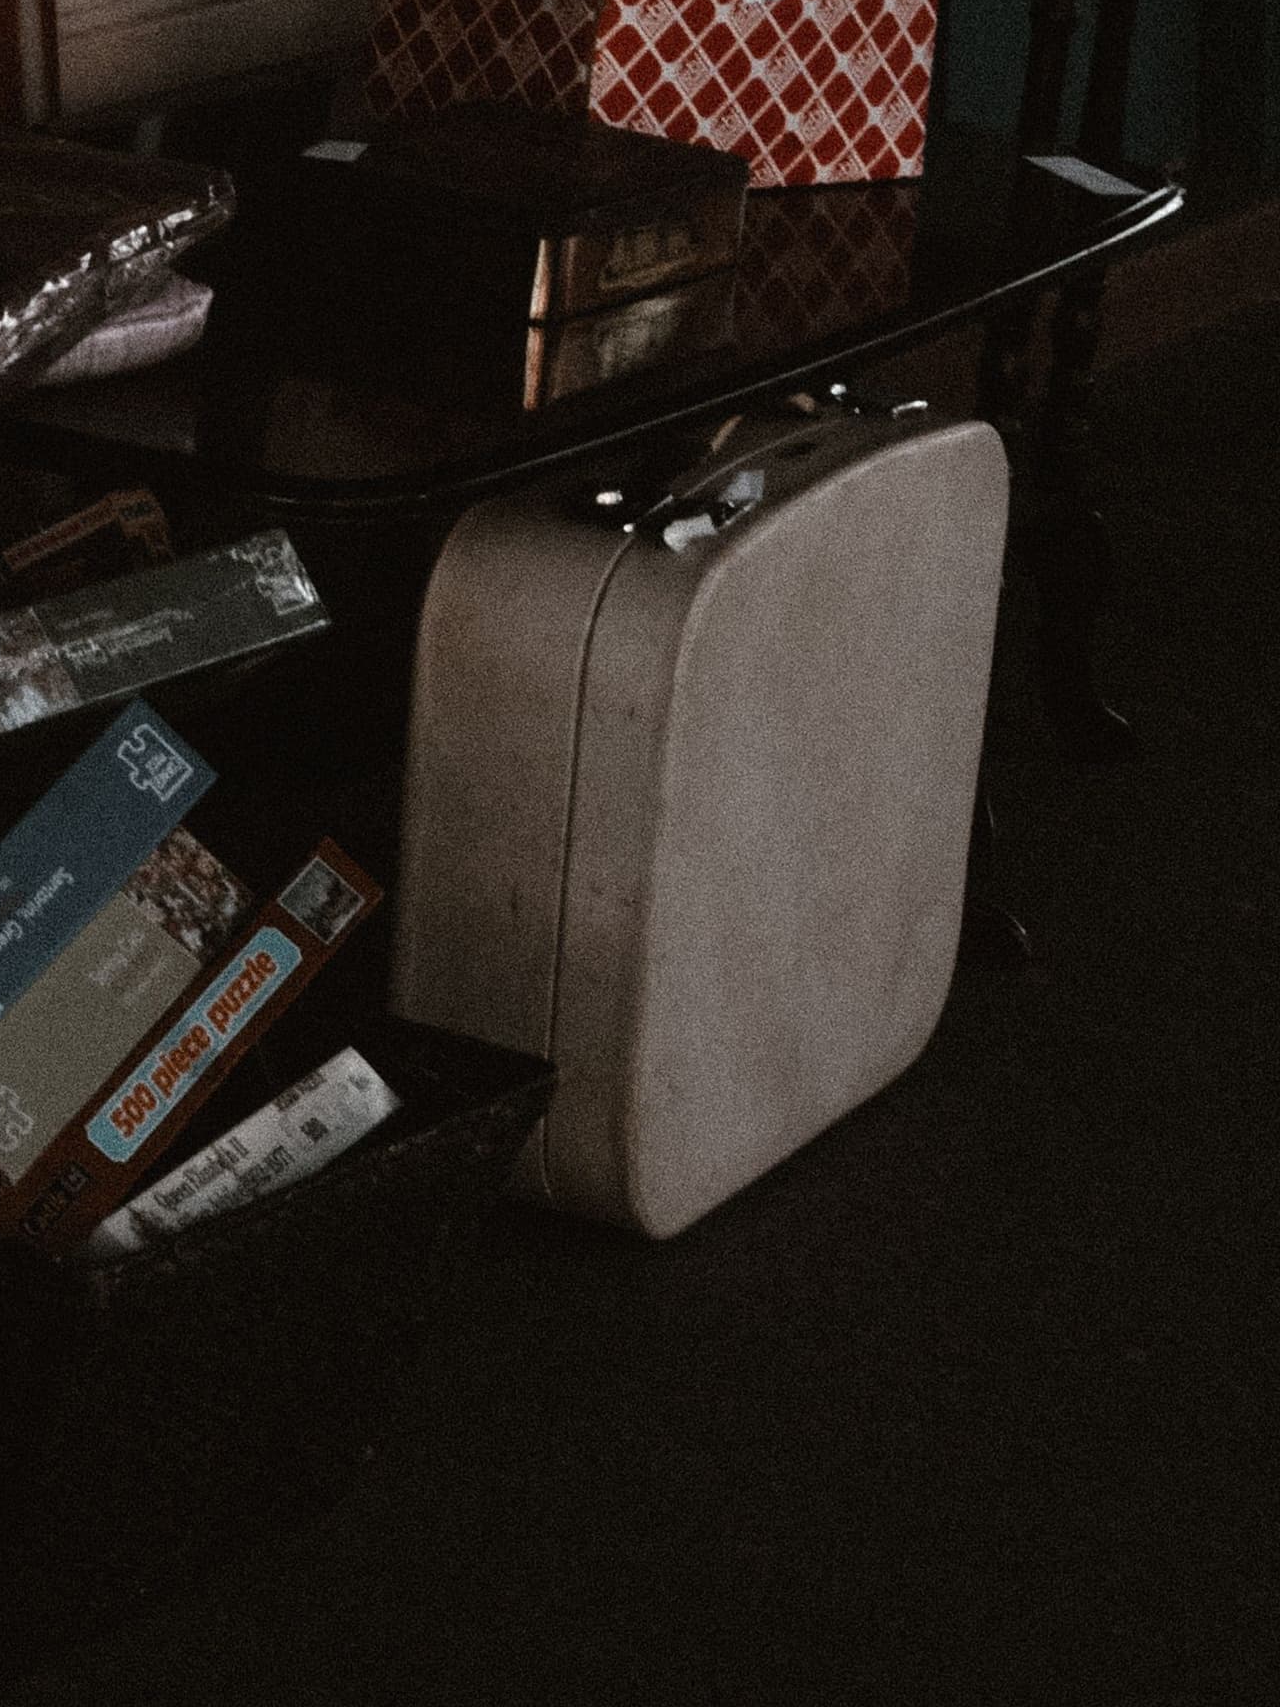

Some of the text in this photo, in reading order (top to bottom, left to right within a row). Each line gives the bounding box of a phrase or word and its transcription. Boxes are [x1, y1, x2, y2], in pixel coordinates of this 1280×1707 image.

[109, 950, 278, 1139] 500 piece puzzle
